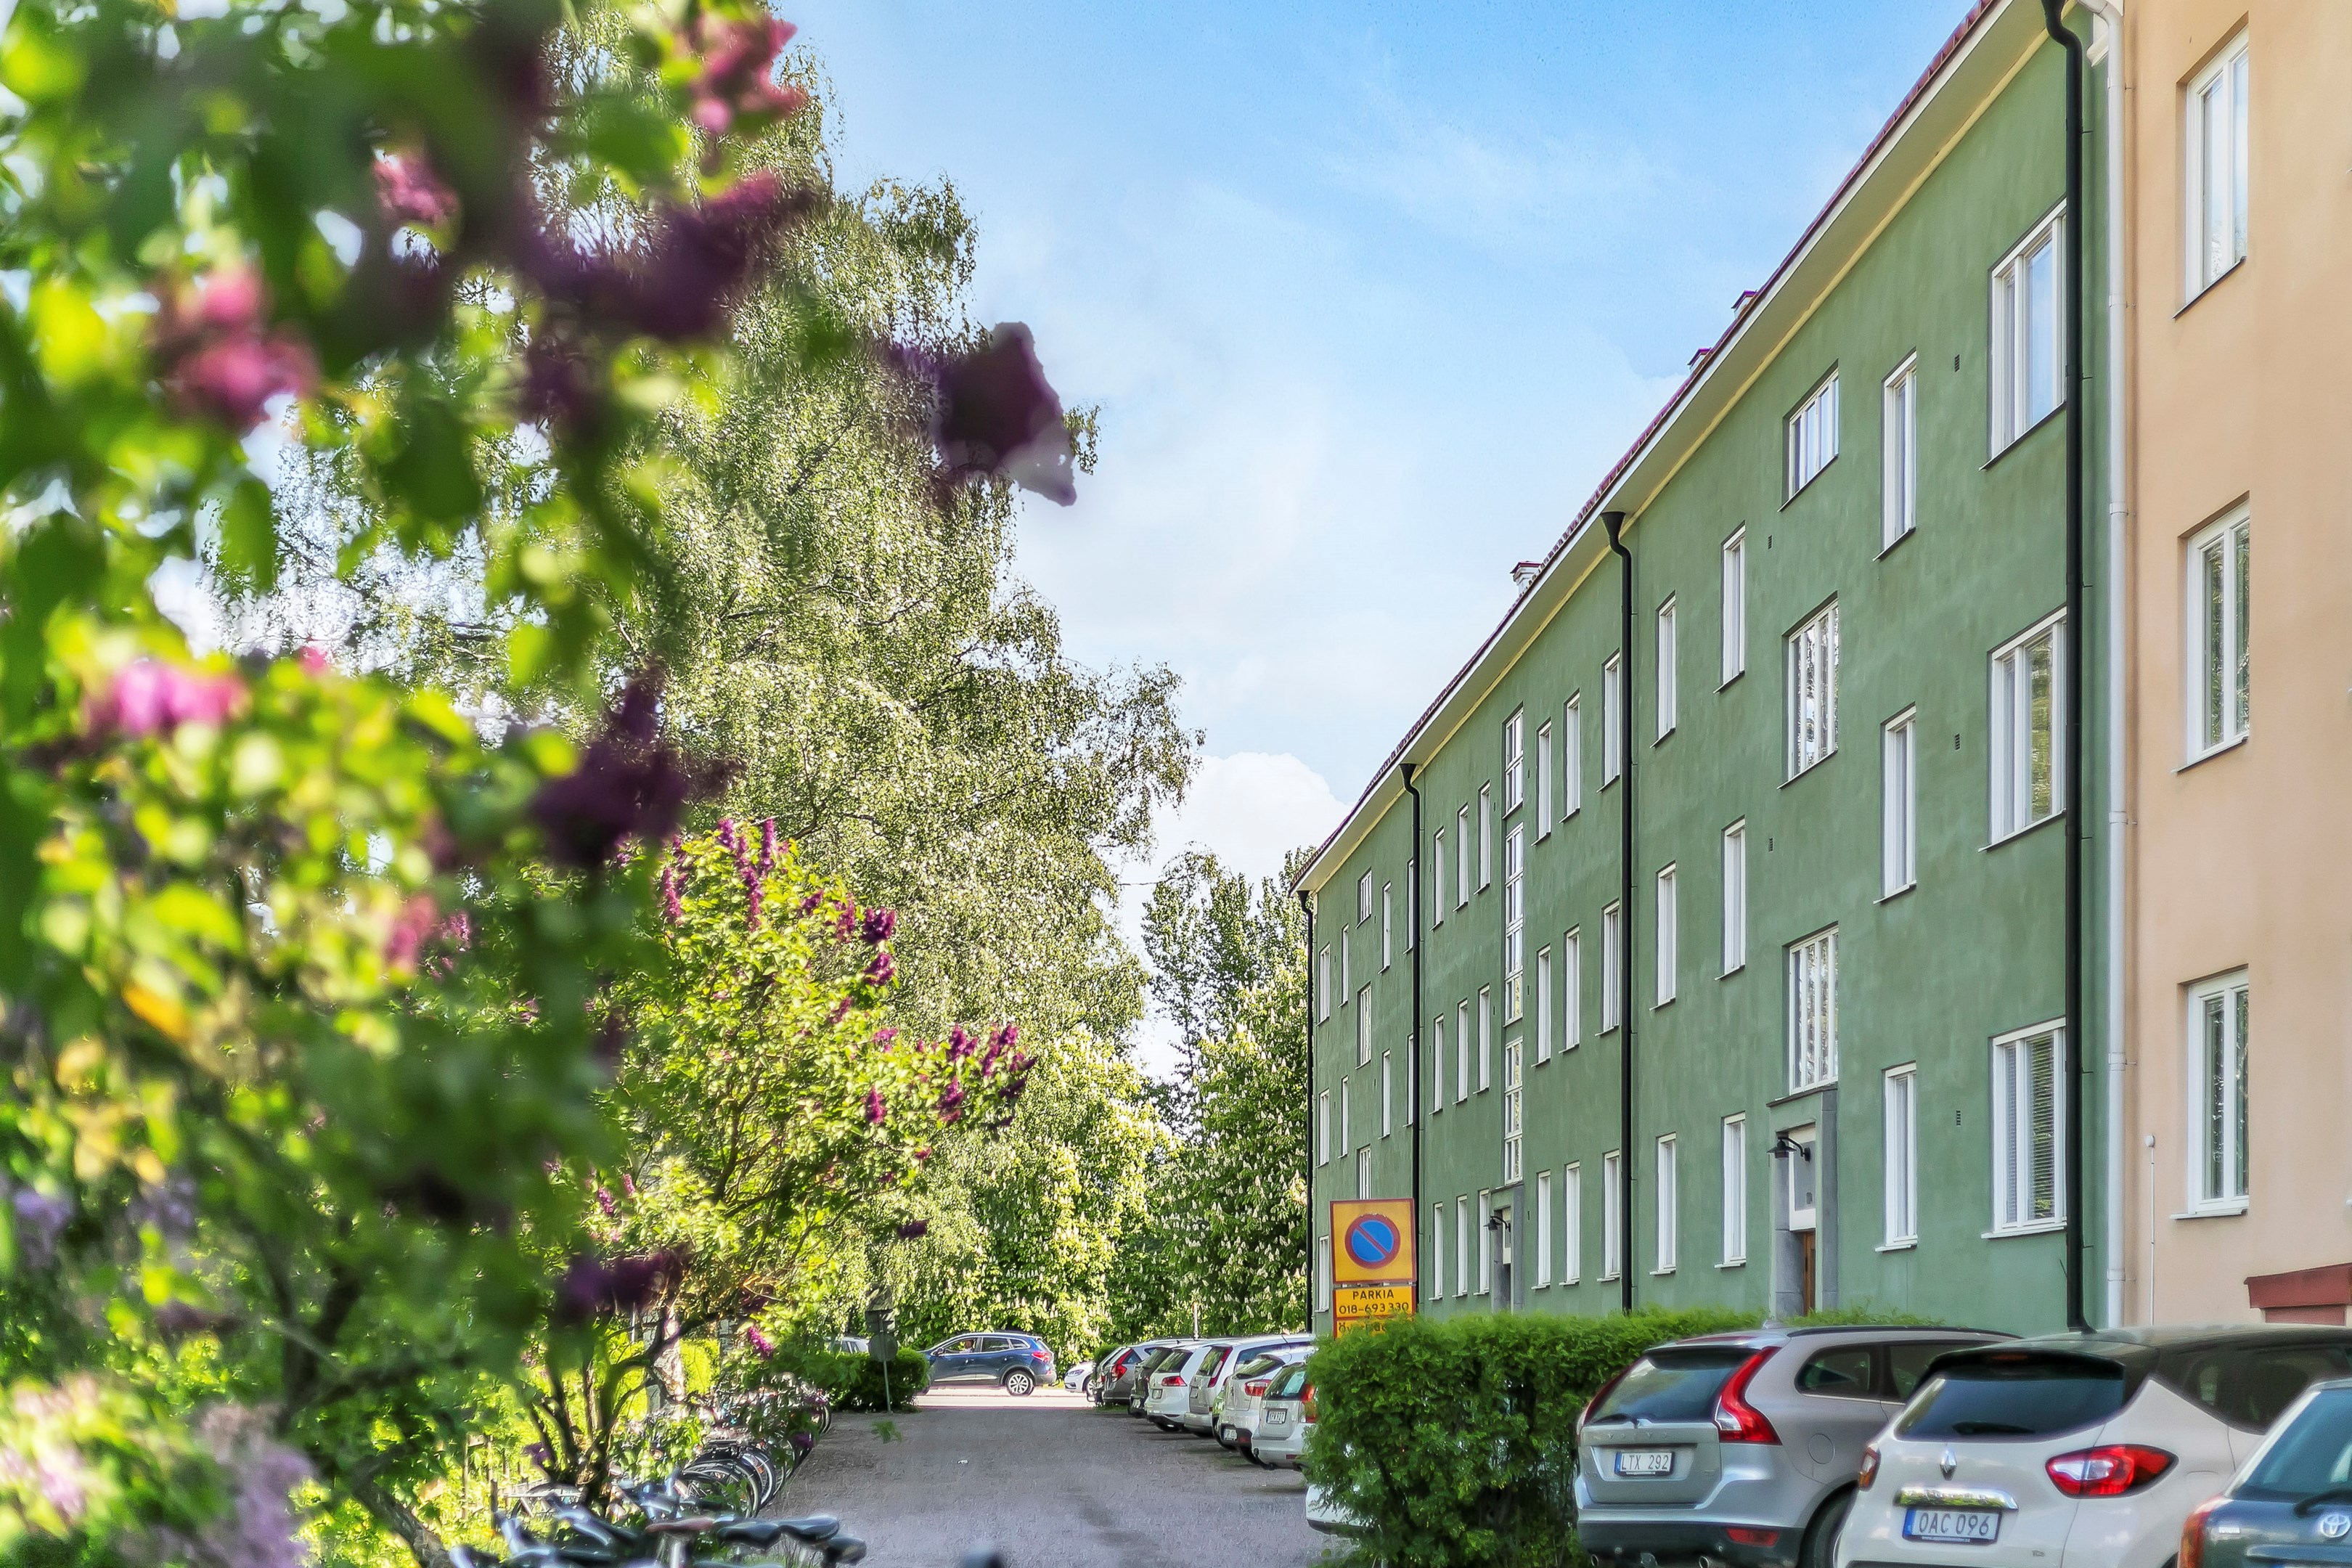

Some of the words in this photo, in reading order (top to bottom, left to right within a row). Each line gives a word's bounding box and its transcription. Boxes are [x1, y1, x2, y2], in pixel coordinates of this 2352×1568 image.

[1352, 1289, 1394, 1300] PARKIA
[1339, 1304, 1386, 1314] 018-693
[1622, 1455, 1641, 1470] LTX
[1648, 1455, 1669, 1469] 292
[1919, 1512, 1951, 1534] OAC
[1956, 1514, 1990, 1536] 096
